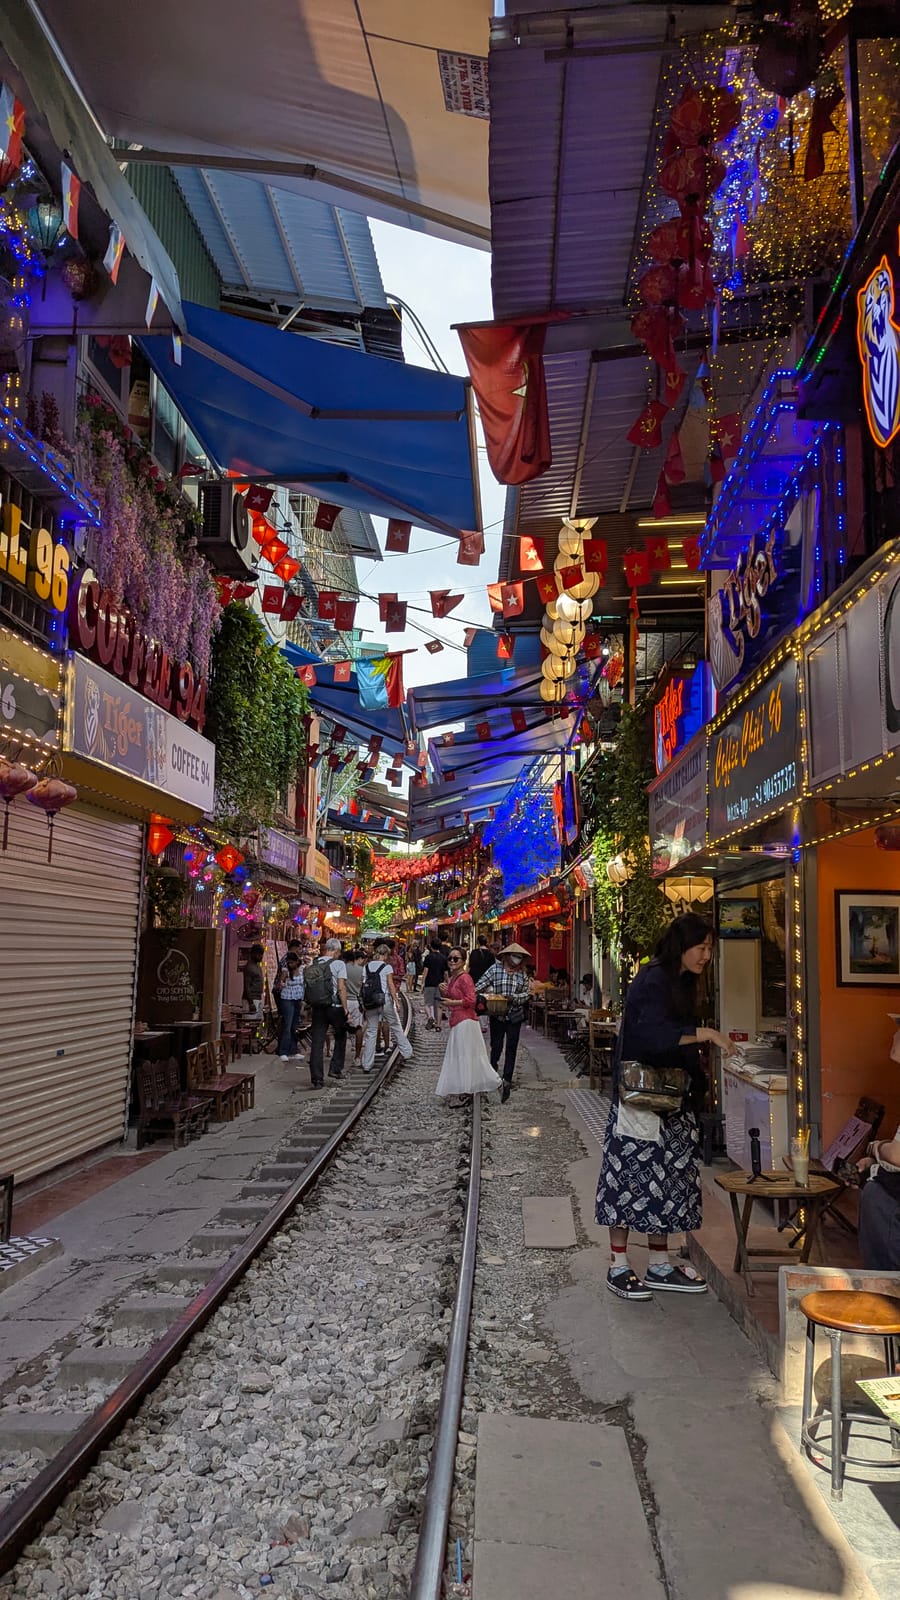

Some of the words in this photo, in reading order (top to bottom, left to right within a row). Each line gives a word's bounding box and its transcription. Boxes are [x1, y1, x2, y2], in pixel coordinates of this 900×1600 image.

[31, 528, 70, 612] 96
[103, 691, 145, 756] Tiger
[176, 660, 208, 735] 94
[659, 677, 684, 749] Tiger
[171, 743, 200, 782] COFFEE
[200, 763, 211, 788] 94
[714, 737, 739, 789] Coffee
[740, 703, 765, 769] Chill
[768, 681, 783, 738] 96
